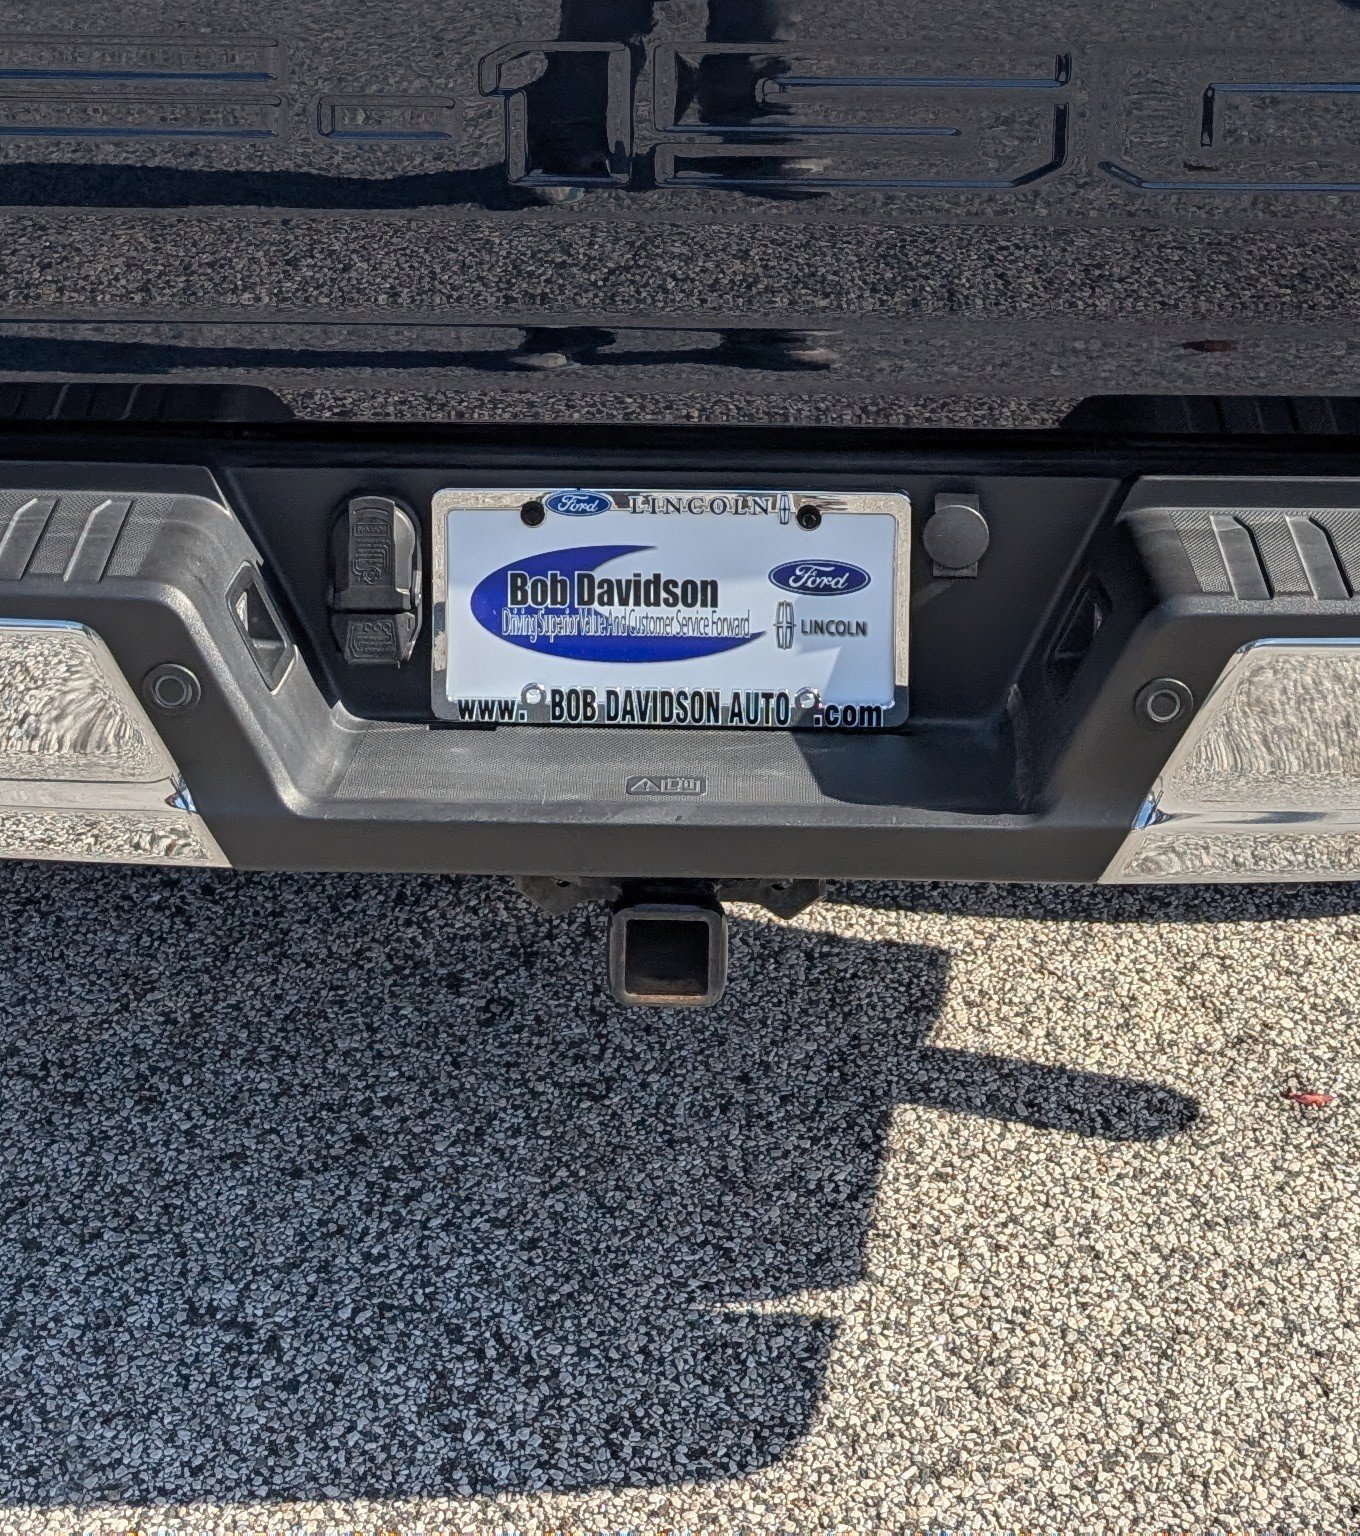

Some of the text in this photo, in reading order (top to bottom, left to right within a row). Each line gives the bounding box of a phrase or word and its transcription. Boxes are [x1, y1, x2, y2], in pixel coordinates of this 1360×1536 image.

[557, 494, 599, 512] Ford
[628, 495, 771, 515] LINCOLN
[788, 564, 850, 589] Ford
[508, 571, 719, 608] Bob Davidson
[502, 609, 751, 642] Driving Superior Value And Customer Service Forward
[801, 618, 867, 637] LINCOLN
[457, 687, 883, 727] www. BOB DAVIDSON AUTO .com
